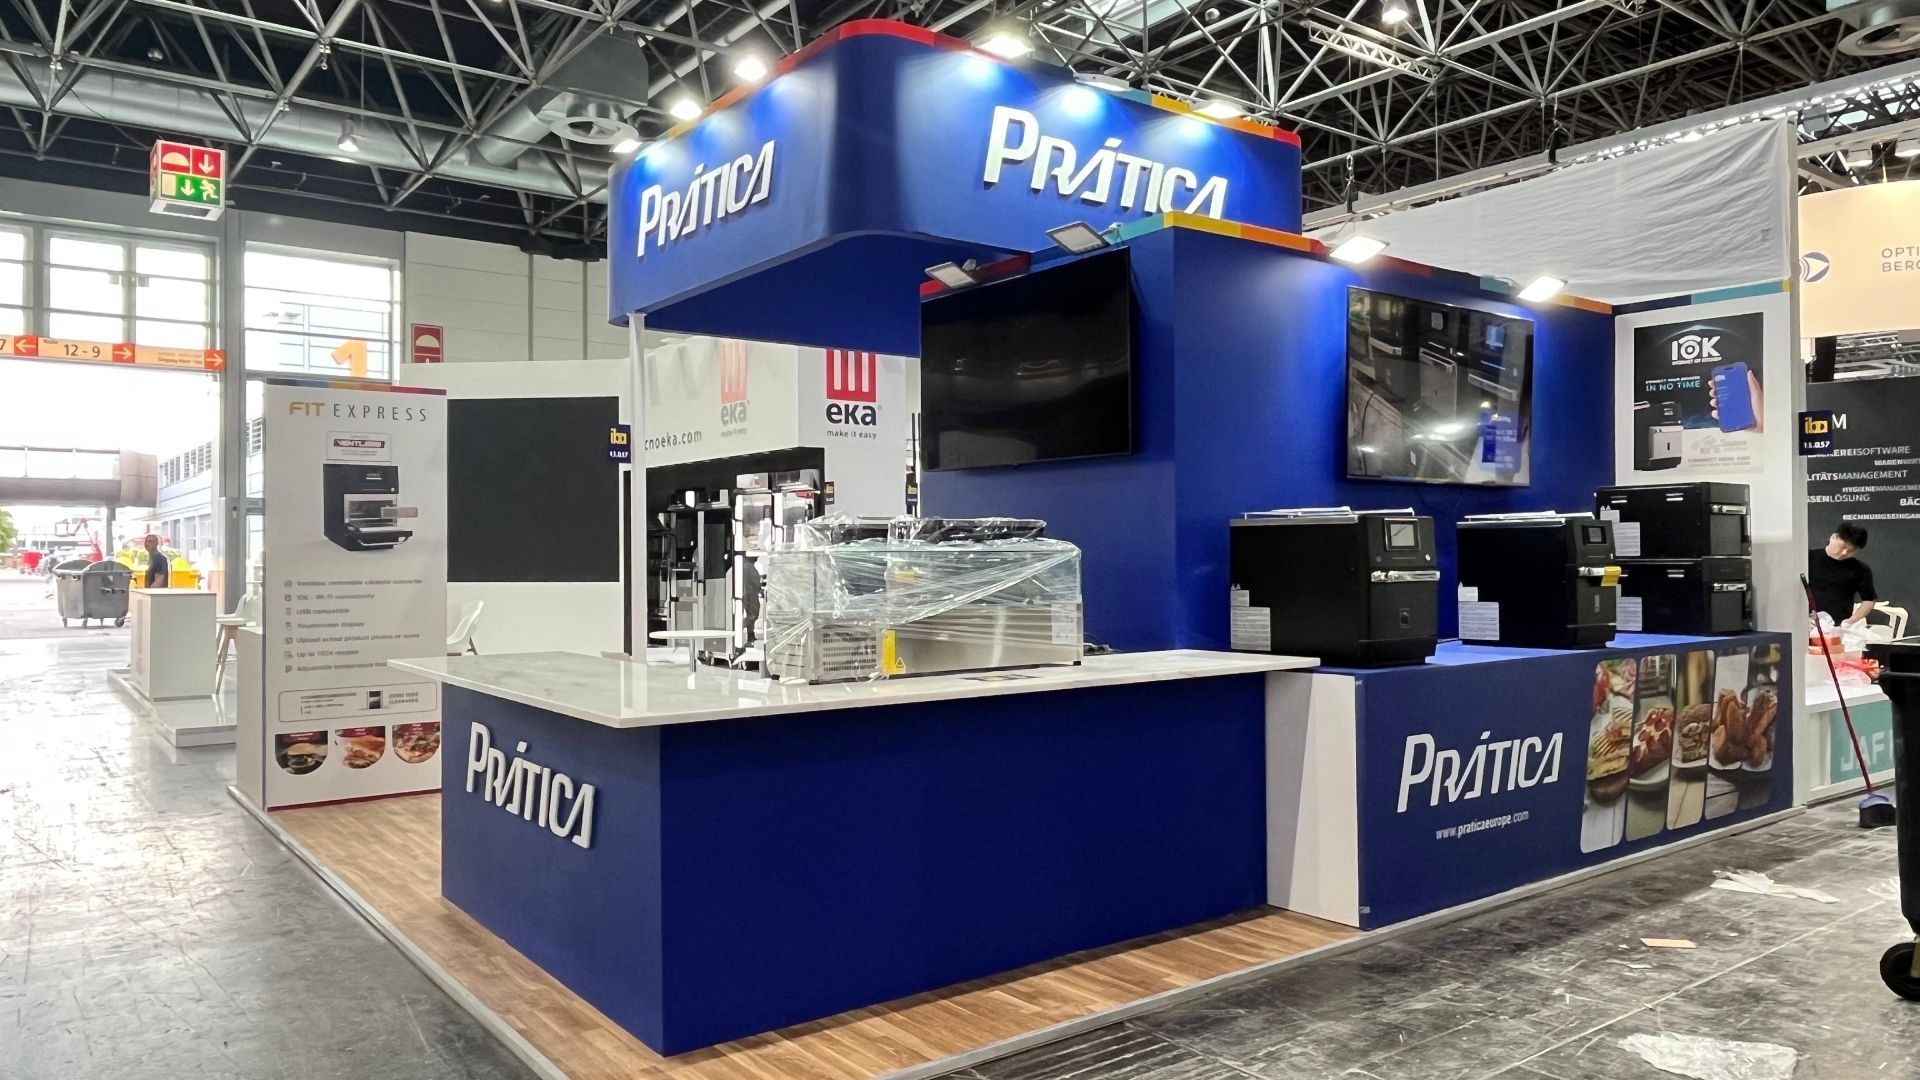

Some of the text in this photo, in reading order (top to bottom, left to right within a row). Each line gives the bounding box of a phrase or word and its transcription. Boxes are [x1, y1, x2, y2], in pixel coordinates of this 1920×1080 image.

[984, 106, 1228, 219] PRÁTICA
[636, 140, 776, 256] PRÁTICA
[63, 343, 78, 357] 12
[92, 346, 101, 358] 9
[330, 338, 368, 376] 1
[1659, 383, 1674, 391] NO
[1676, 380, 1701, 389] TIME
[289, 401, 427, 422] FIT EXPRESS
[720, 401, 747, 426] eka
[825, 402, 877, 426] eka
[826, 429, 849, 438] make
[858, 432, 877, 440] easy
[1807, 446, 1911, 458] EREISOFTWARE
[1840, 729, 1893, 773] JAF
[466, 721, 596, 849] PRÁTICA
[1396, 731, 1564, 813] PRÁTICA
[1435, 811, 1530, 840] www.praticaeurope.com
